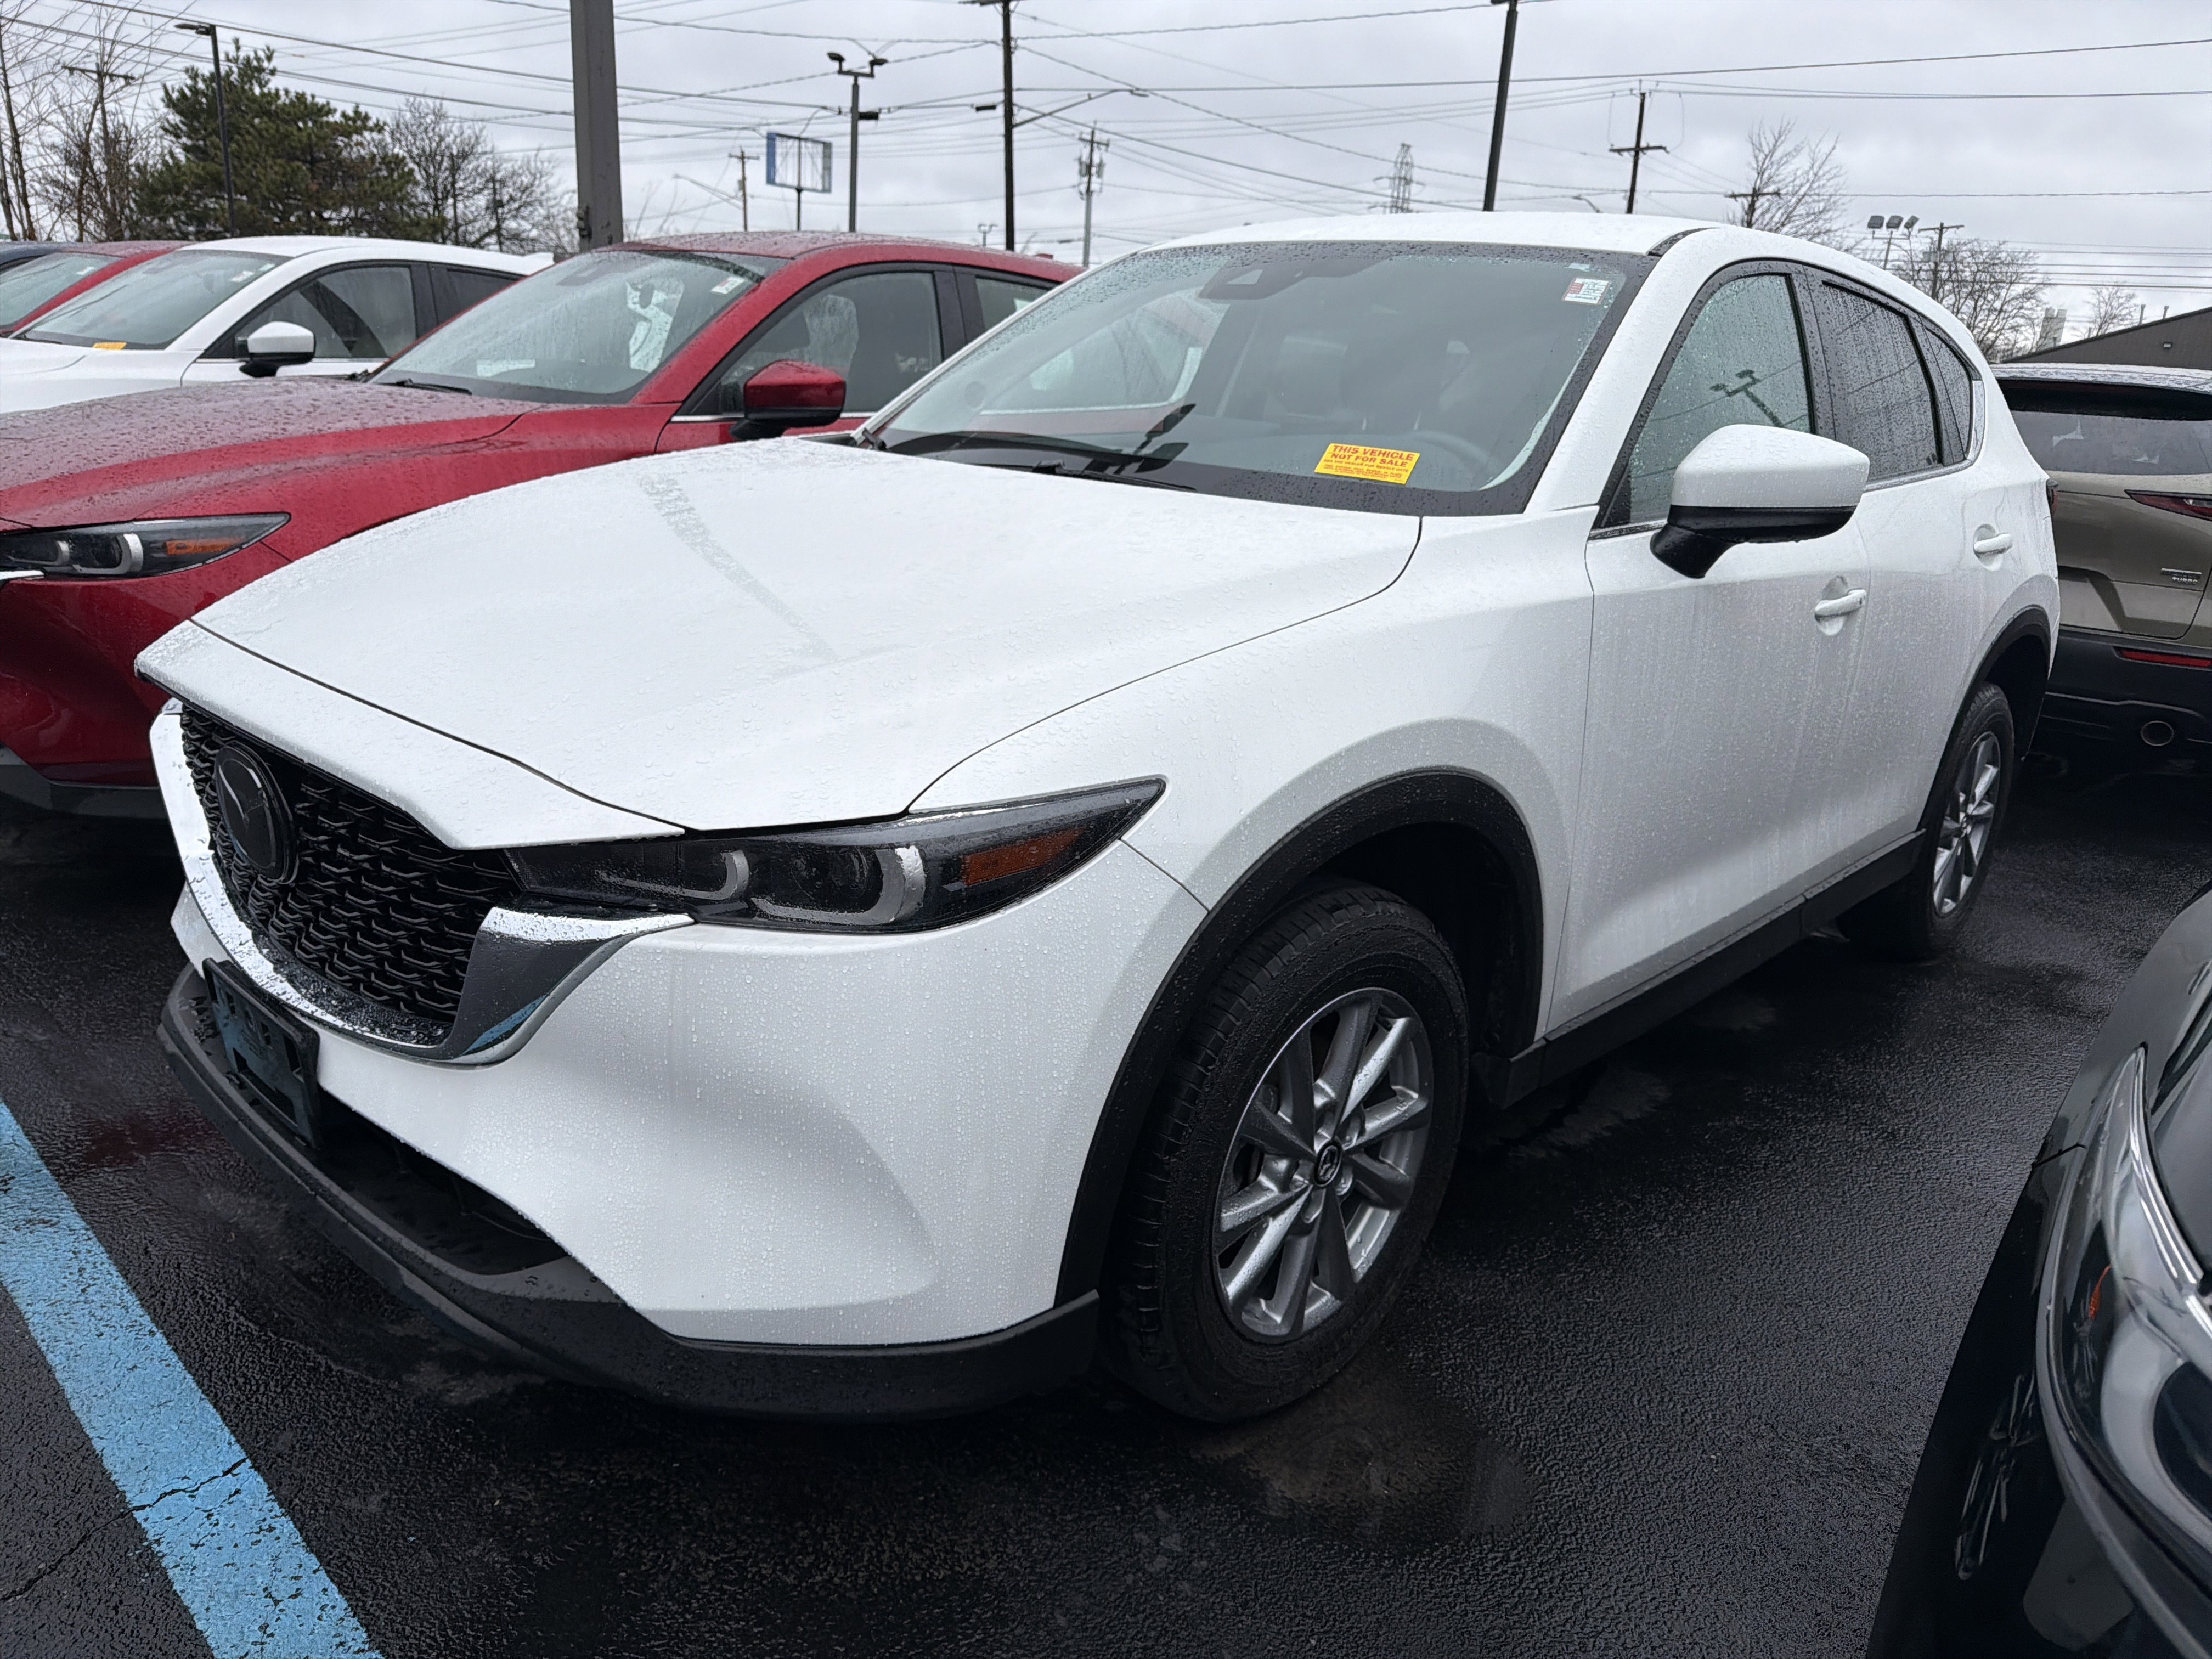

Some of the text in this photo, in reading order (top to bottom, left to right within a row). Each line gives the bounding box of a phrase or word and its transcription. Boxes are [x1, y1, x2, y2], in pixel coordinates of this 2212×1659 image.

[1333, 445, 1415, 461] THIS VEHICLE
[1379, 458, 1408, 467] SALE
